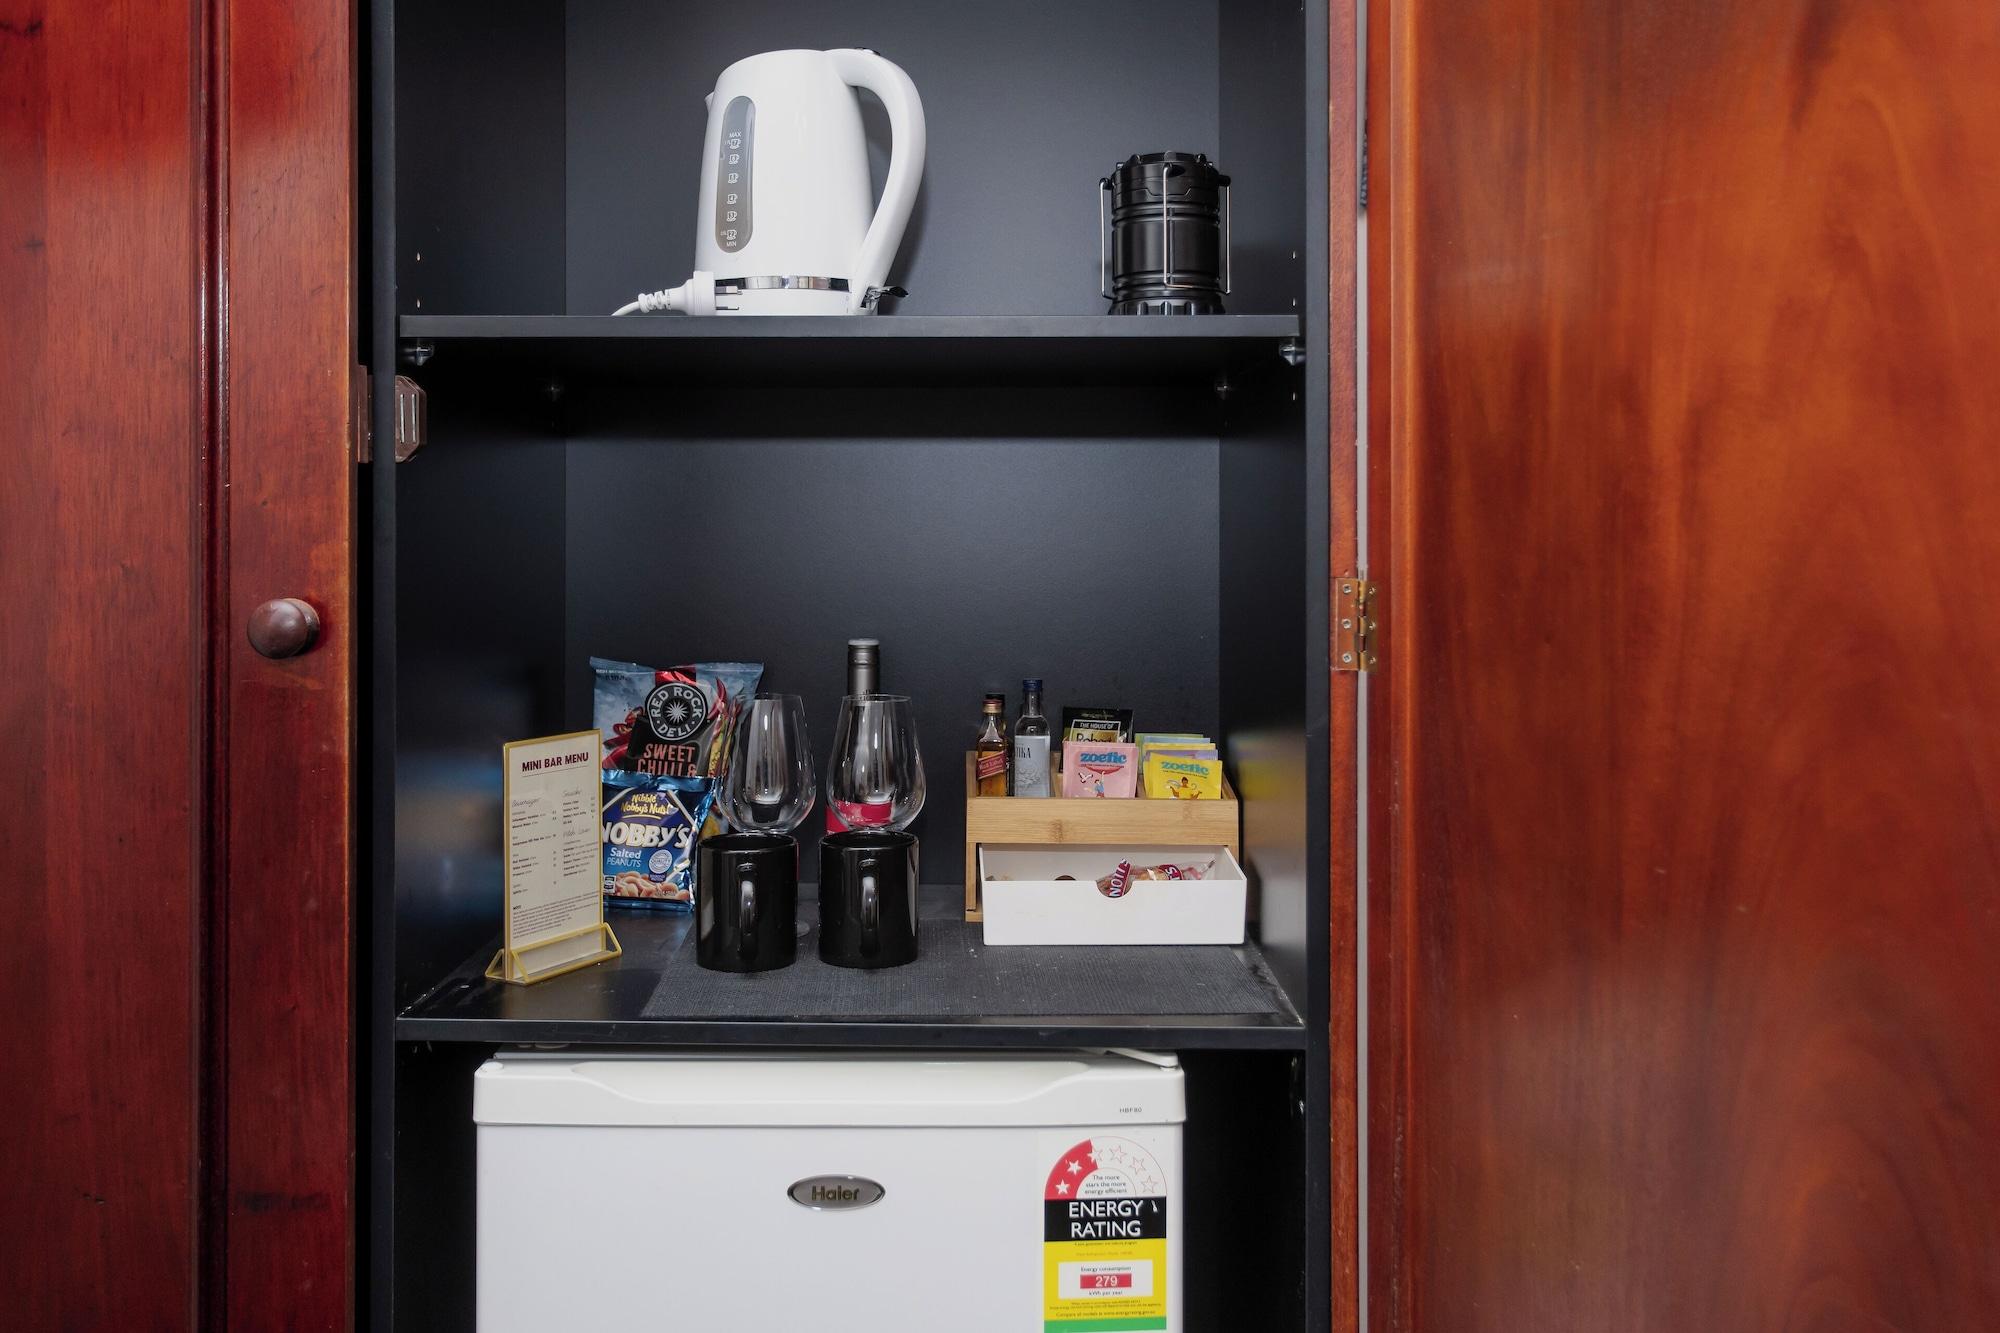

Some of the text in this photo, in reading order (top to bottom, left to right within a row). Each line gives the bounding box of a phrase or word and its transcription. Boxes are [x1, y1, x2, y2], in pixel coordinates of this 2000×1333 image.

[651, 687, 702, 718] RED ROCK
[658, 724, 691, 737] DELI
[643, 743, 695, 761] SWEET
[1080, 752, 1127, 764] zoetic
[522, 752, 589, 772] MINI BAR MENU
[1161, 761, 1209, 775] zoetic
[610, 847, 641, 859] Salted
[606, 857, 641, 868] PEANUTS
[811, 1185, 860, 1201] Haier
[1068, 1200, 1144, 1218] ENERGY
[1071, 1220, 1141, 1238] RATING
[1095, 1275, 1118, 1288] 279
